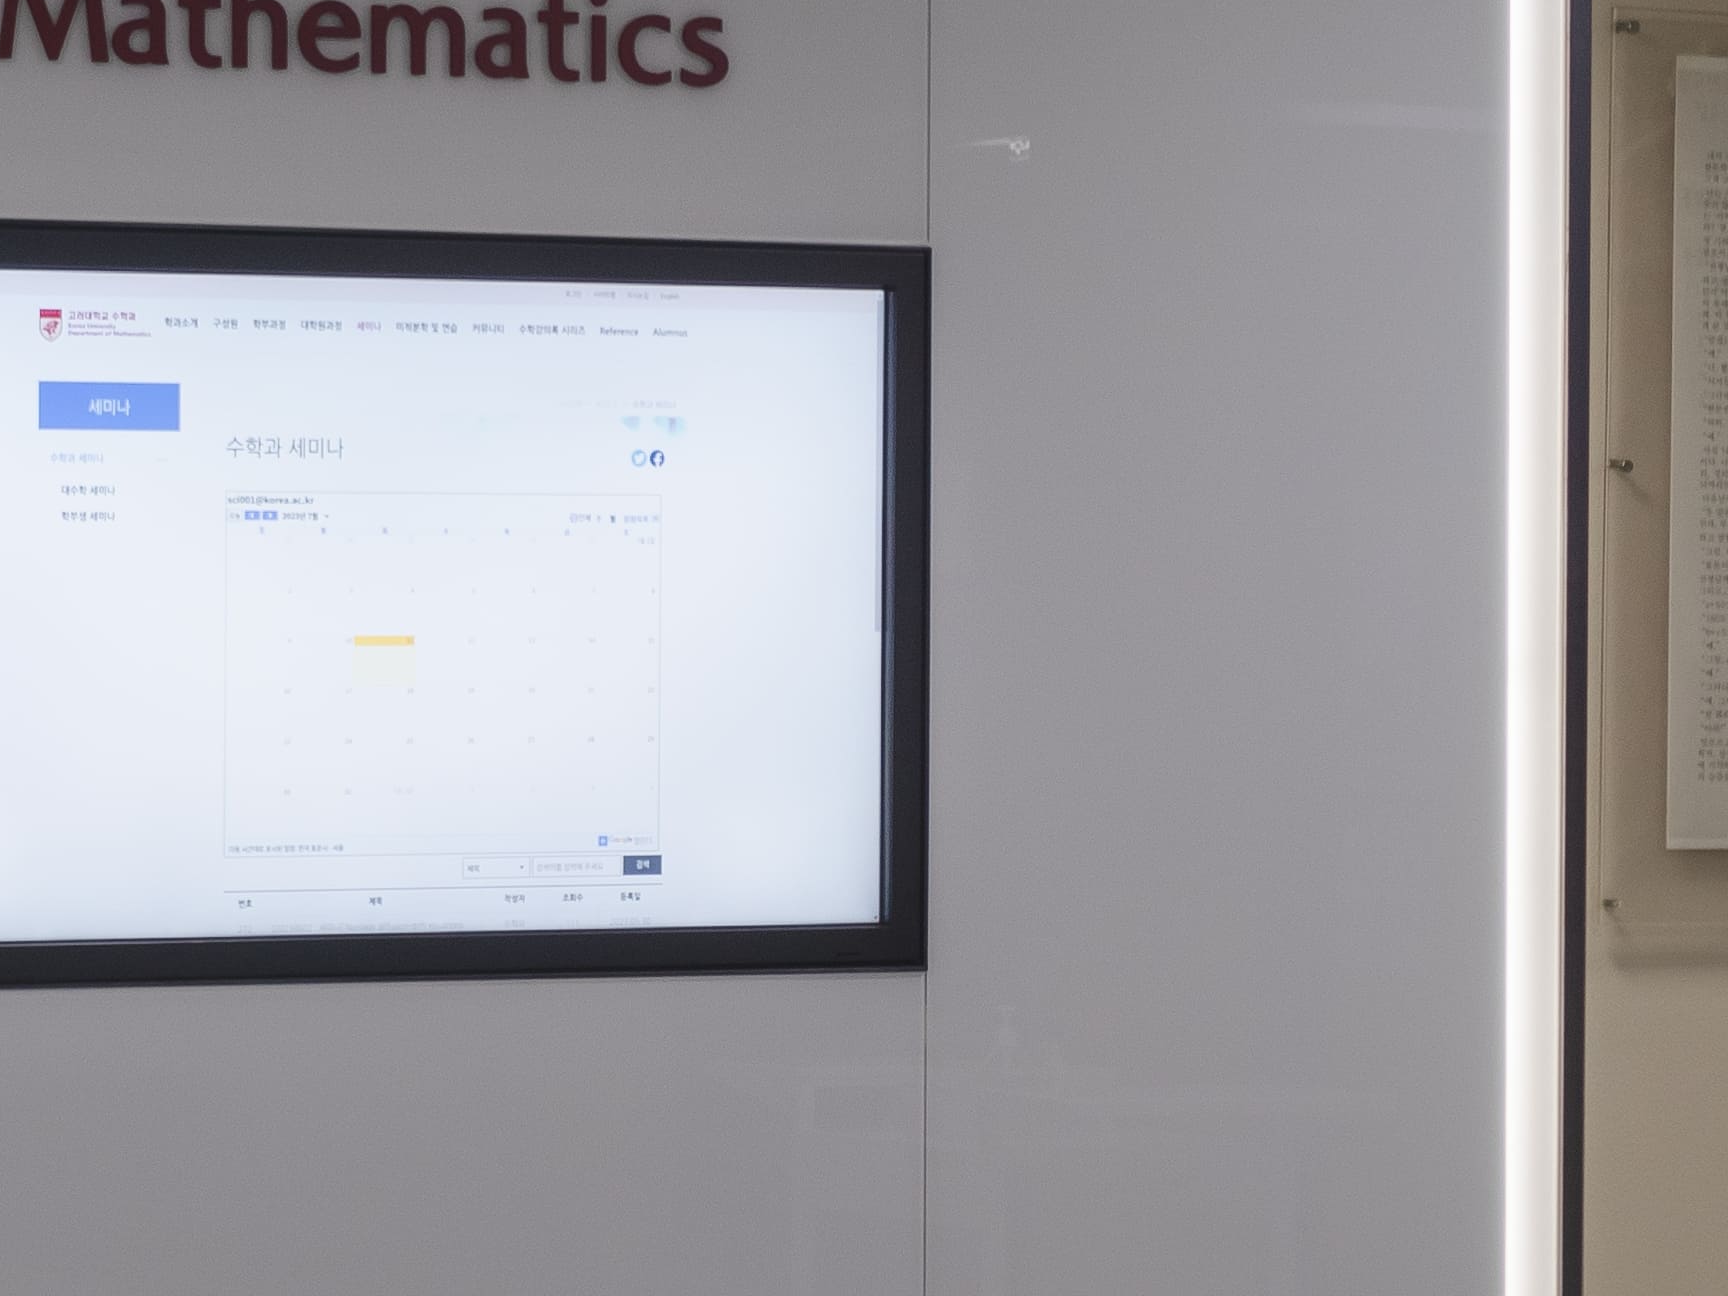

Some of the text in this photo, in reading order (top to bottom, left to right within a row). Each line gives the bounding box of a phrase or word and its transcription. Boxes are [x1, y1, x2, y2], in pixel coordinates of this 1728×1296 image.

[69, 311, 109, 322] 고려대학교
[112, 311, 136, 322] 수학과
[164, 316, 199, 328] 학과소개
[213, 317, 239, 329] 구성원
[253, 318, 286, 330] 학부과정
[300, 319, 343, 332] 대학원과정
[357, 320, 382, 332] 세미나
[395, 321, 429, 333] 미적분학
[472, 323, 505, 334] 커뮤니티
[561, 325, 586, 336] 시리즈
[600, 327, 639, 336] Reference
[88, 398, 131, 417] 세미나
[226, 436, 345, 461] 수학과 세미나
[50, 452, 104, 464] 수학과 세미나
[61, 485, 116, 496] 대수학 세미나
[90, 511, 116, 522] 세미나
